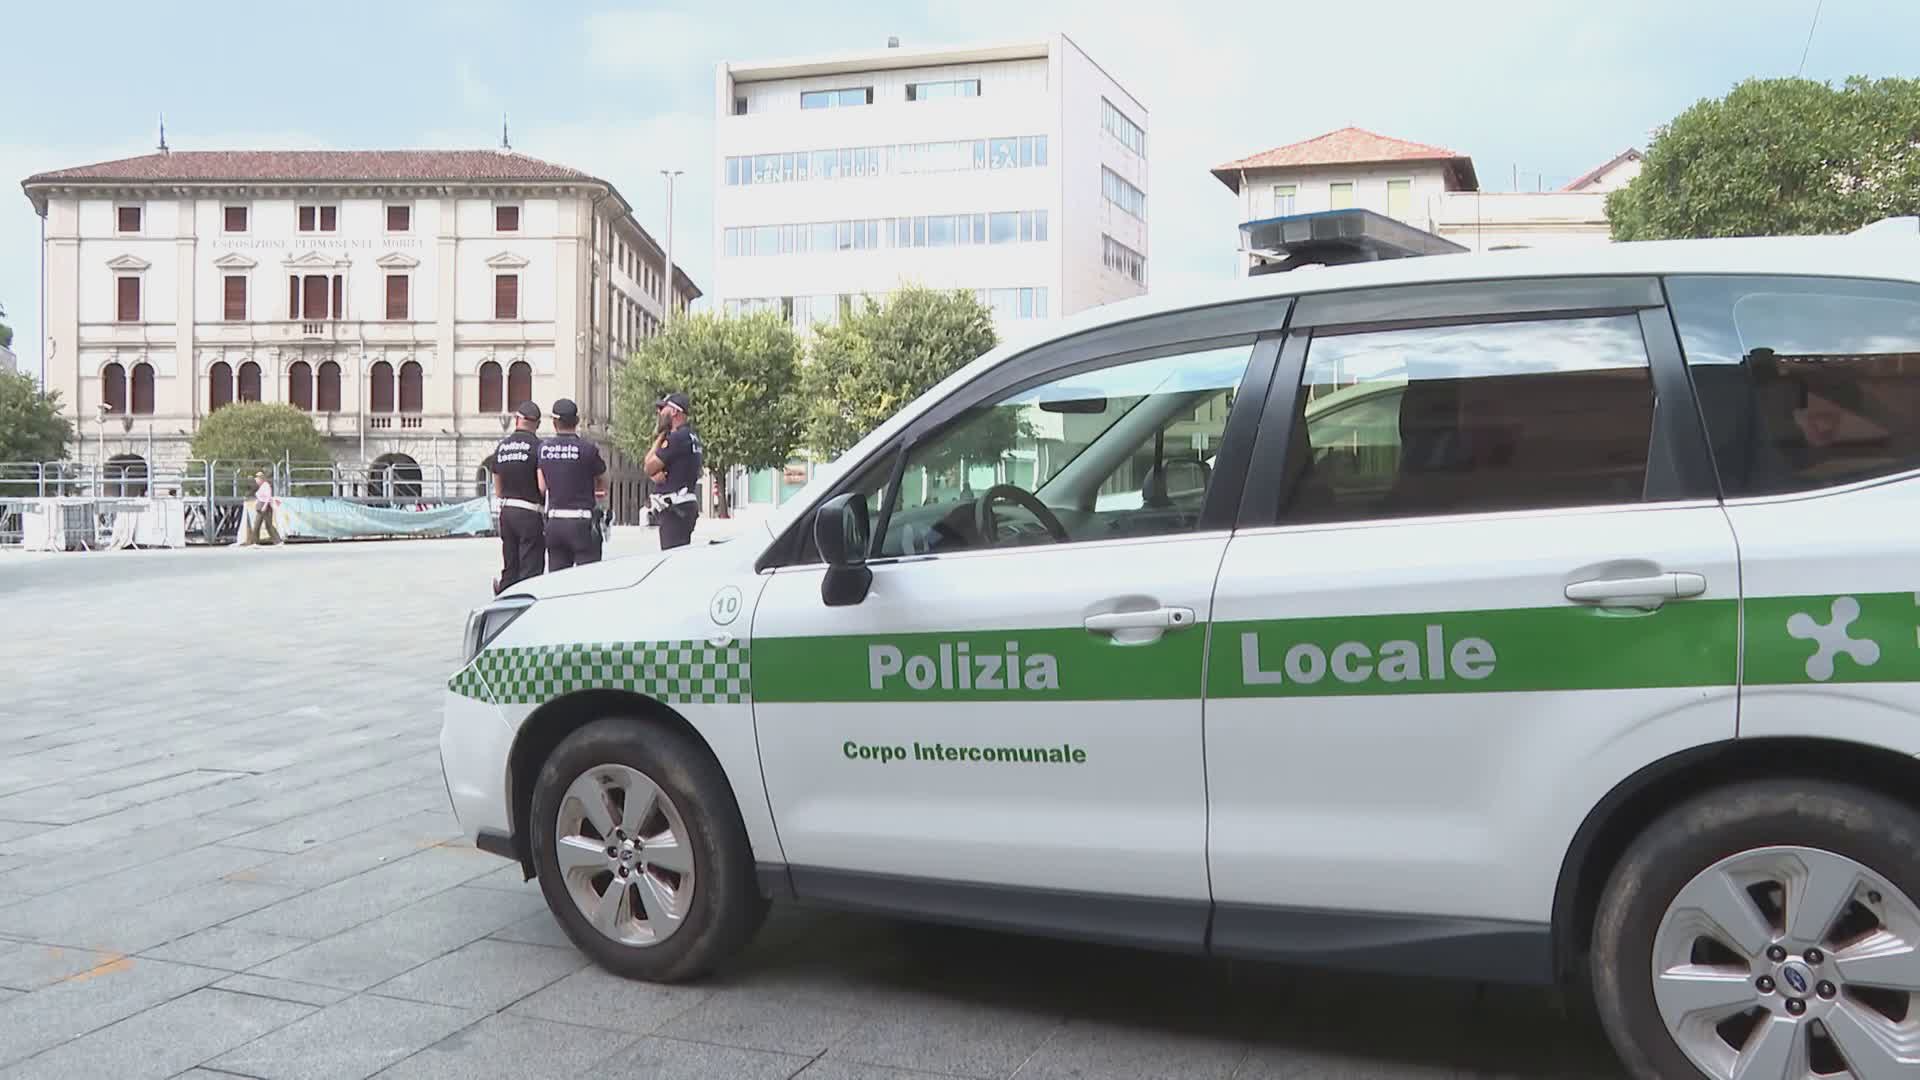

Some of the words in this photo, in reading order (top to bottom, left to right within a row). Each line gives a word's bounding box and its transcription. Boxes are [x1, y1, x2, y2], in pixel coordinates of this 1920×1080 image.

[499, 441, 530, 452] Polizia
[541, 444, 578, 453] Polizia
[497, 452, 528, 463] Locale
[541, 451, 578, 460] Locale
[717, 597, 737, 614] 10
[868, 641, 1059, 690] Polizia
[1241, 624, 1496, 685] Locale
[843, 741, 907, 764] Corpo
[914, 742, 1087, 763] Intercomunale
